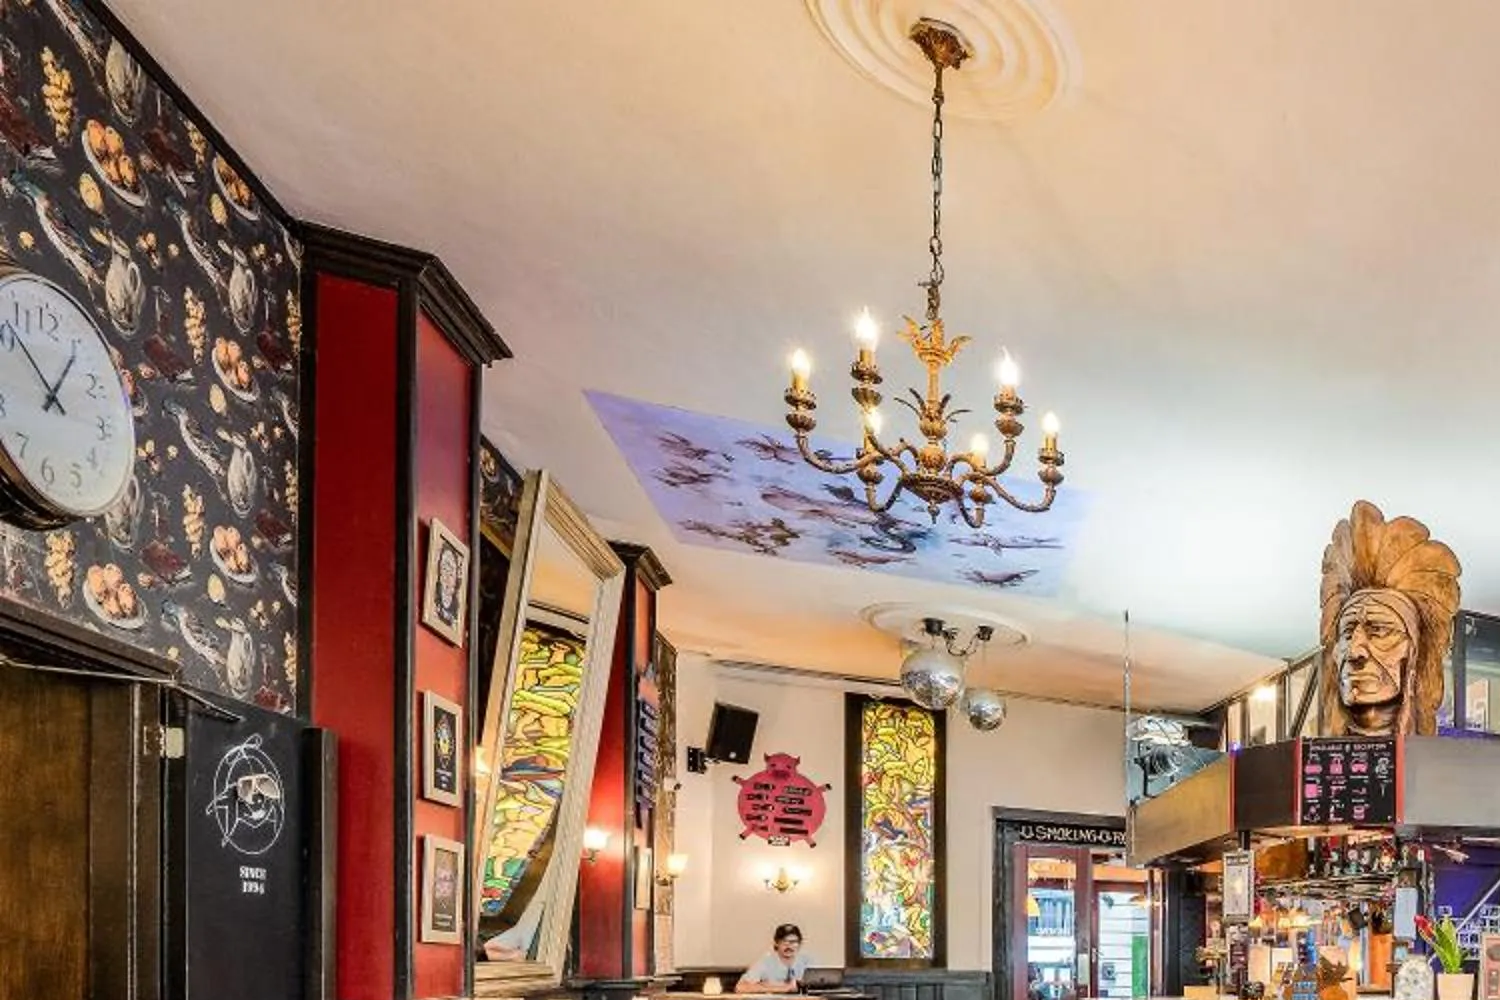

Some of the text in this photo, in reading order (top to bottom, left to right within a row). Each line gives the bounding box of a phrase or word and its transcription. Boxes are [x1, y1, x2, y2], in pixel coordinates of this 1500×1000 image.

[37, 304, 59, 341] 12
[16, 431, 30, 459] 7
[40, 457, 56, 486] 6
[69, 462, 83, 489] 5
